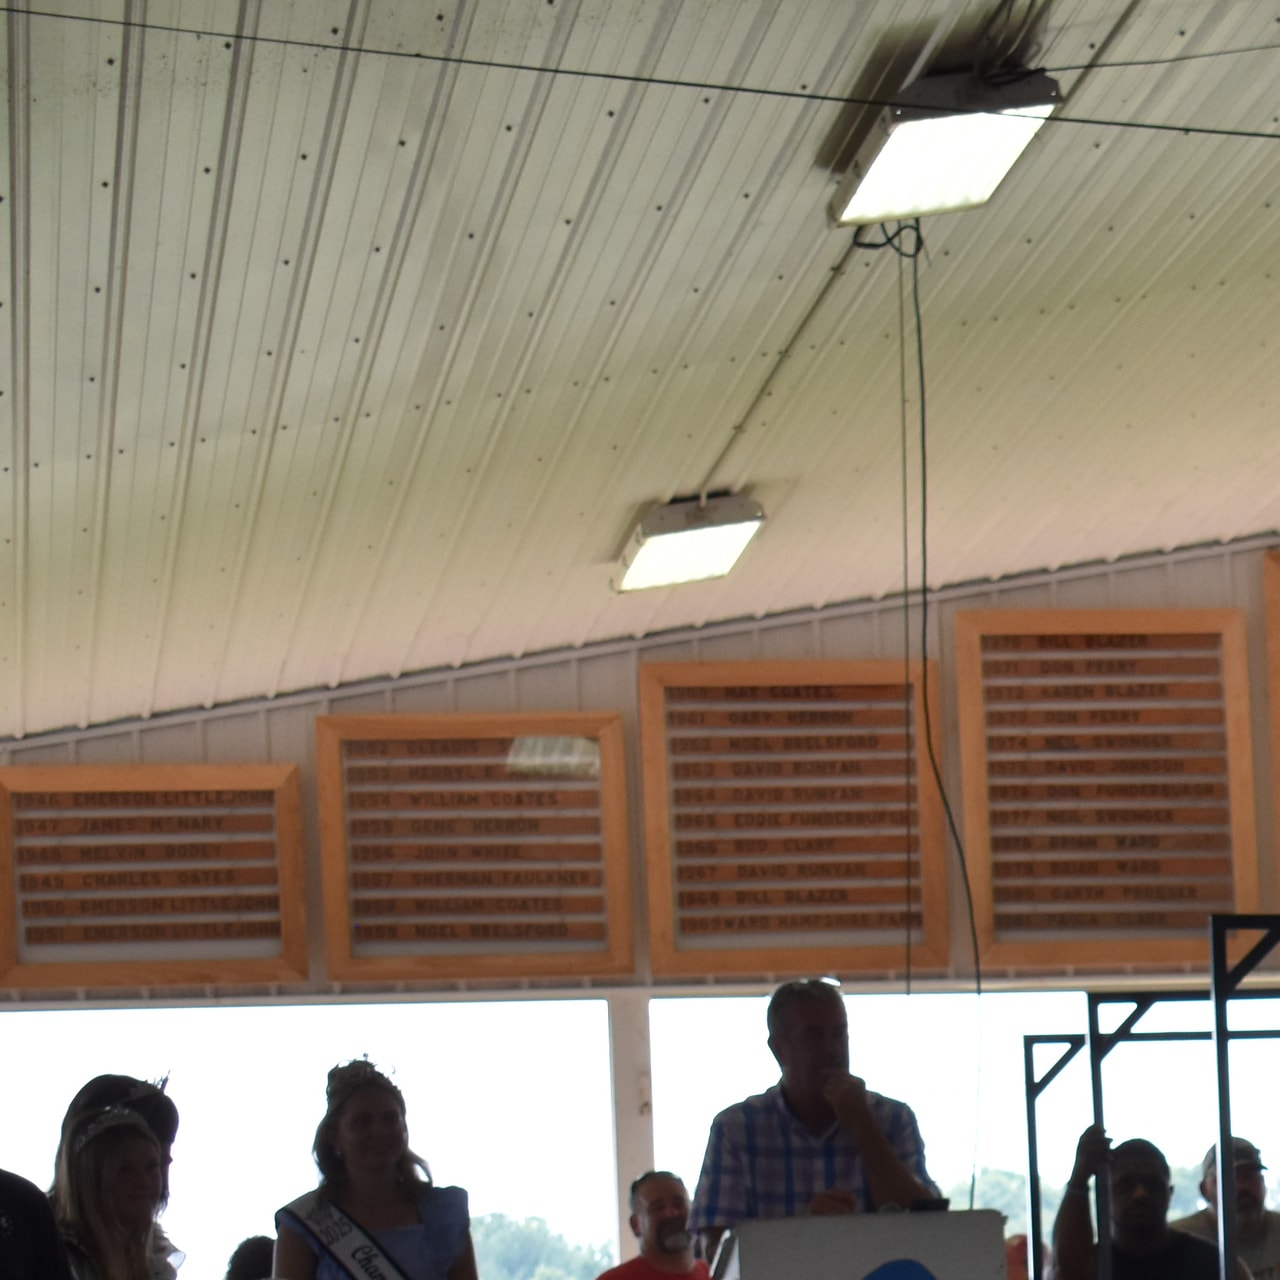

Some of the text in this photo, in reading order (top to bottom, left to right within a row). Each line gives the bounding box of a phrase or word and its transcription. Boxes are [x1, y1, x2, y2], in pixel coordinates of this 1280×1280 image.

[410, 793, 558, 806] WILLIAM COATES
[80, 817, 136, 831] JAMES
[80, 845, 146, 859] MELVIN
[412, 872, 492, 885] SHERMAN
[503, 871, 589, 884] FAULKNER
[737, 865, 786, 877] DAVID
[82, 872, 161, 886] CHARLES
[80, 899, 164, 913] EMERSON
[414, 899, 484, 912] WILLIAM
[83, 925, 166, 940] EMERSON
